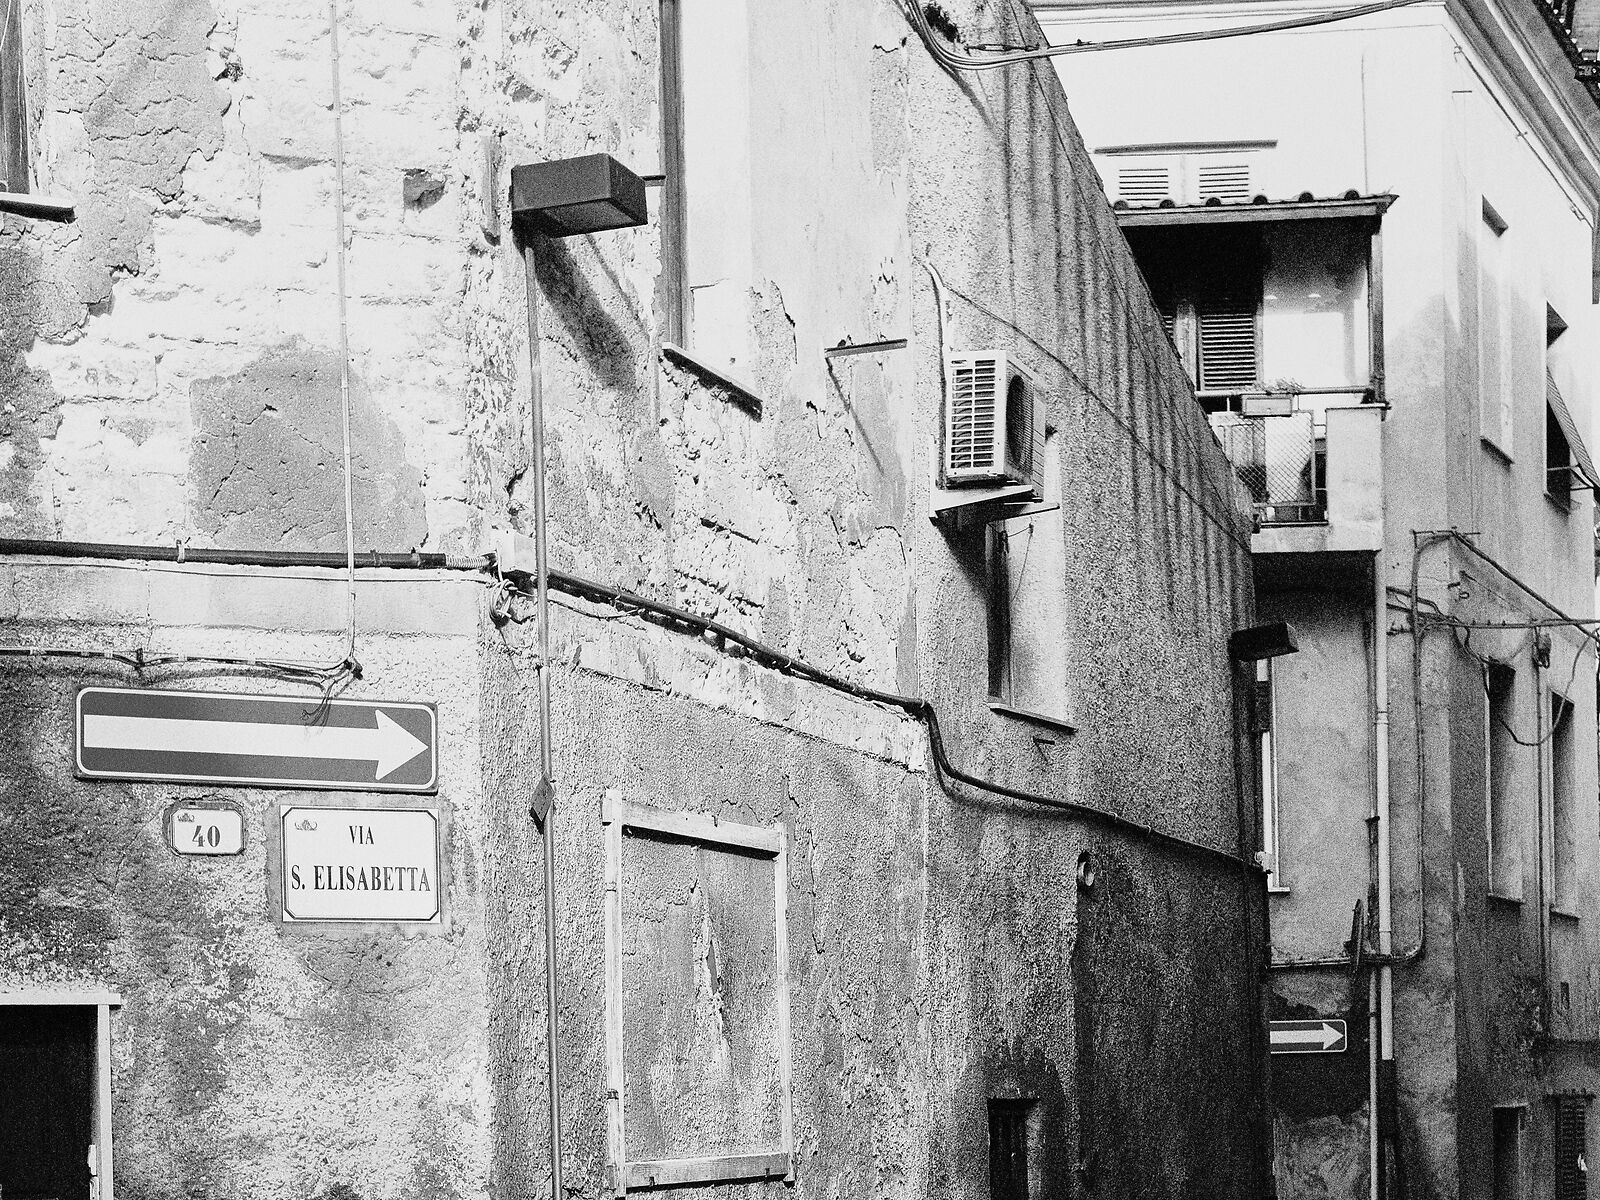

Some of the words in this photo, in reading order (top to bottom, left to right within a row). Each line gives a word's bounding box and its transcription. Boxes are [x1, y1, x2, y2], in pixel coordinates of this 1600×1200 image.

[192, 825, 221, 847] 40
[349, 825, 375, 845] VIA
[291, 864, 306, 890] S.
[313, 865, 431, 892] ELISABETTA
